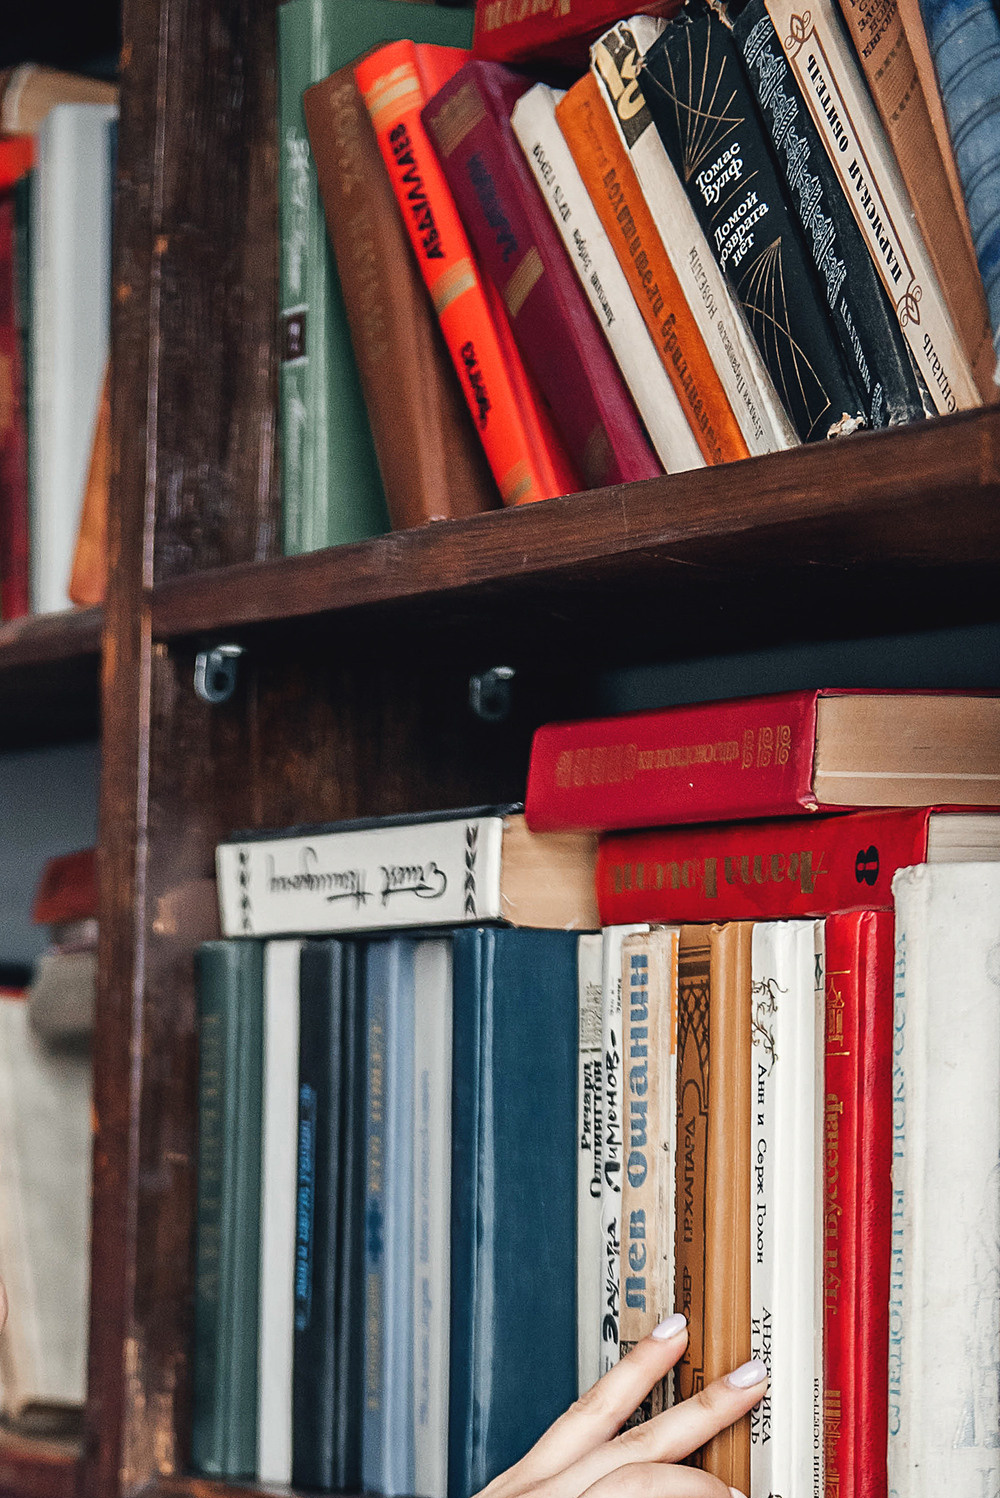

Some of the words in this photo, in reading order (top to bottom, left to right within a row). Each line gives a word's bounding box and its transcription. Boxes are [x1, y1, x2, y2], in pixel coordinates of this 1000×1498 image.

[806, 53, 849, 153] ОБИТЕЛЬ
[388, 122, 445, 260] АБДУЛЛАЕВ
[695, 142, 741, 193] Томас
[702, 158, 743, 207] Вулф
[713, 191, 760, 252] Домой
[732, 232, 755, 267] нет
[847, 157, 904, 286] ПАРМСКАЯ
[687, 245, 718, 320] НОВЕЛЛЫ
[922, 332, 958, 413] ендаль
[854, 844, 880, 887] 8
[626, 954, 650, 1189] Ошанин
[757, 1063, 768, 1105] Анн
[580, 1061, 595, 1151] Ричард
[758, 1113, 765, 1126] и
[755, 1138, 768, 1196] Серж
[625, 1208, 647, 1313] Лев
[757, 1203, 767, 1264] Голон
[752, 1319, 760, 1335] И
[762, 1306, 772, 1446] АНЖИКА
